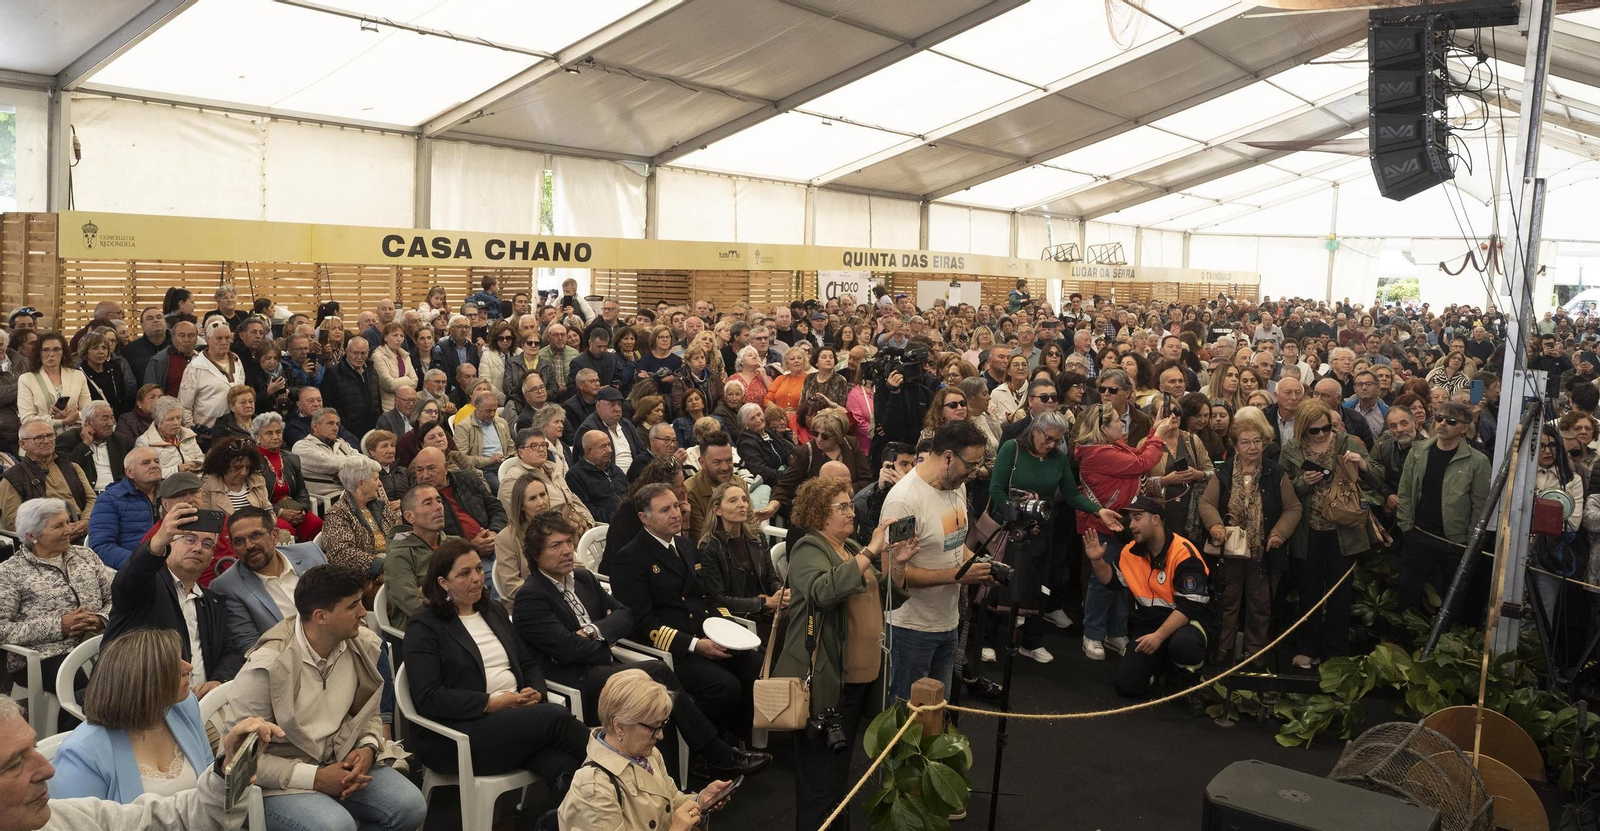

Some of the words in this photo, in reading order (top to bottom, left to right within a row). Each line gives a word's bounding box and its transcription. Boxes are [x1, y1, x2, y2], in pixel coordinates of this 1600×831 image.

[381, 234, 473, 260] CASA
[484, 238, 592, 263] CHANO
[842, 250, 897, 268] QUINTA
[901, 253, 929, 268] DAS
[932, 255, 965, 270] EIRAS
[1071, 266, 1098, 278] LUGAR
[1099, 266, 1110, 278] DA
[1112, 268, 1135, 279] SERRA
[1201, 272, 1205, 280] O
[1206, 271, 1232, 281] TRANQUILO
[825, 281, 859, 301] CHOCO
